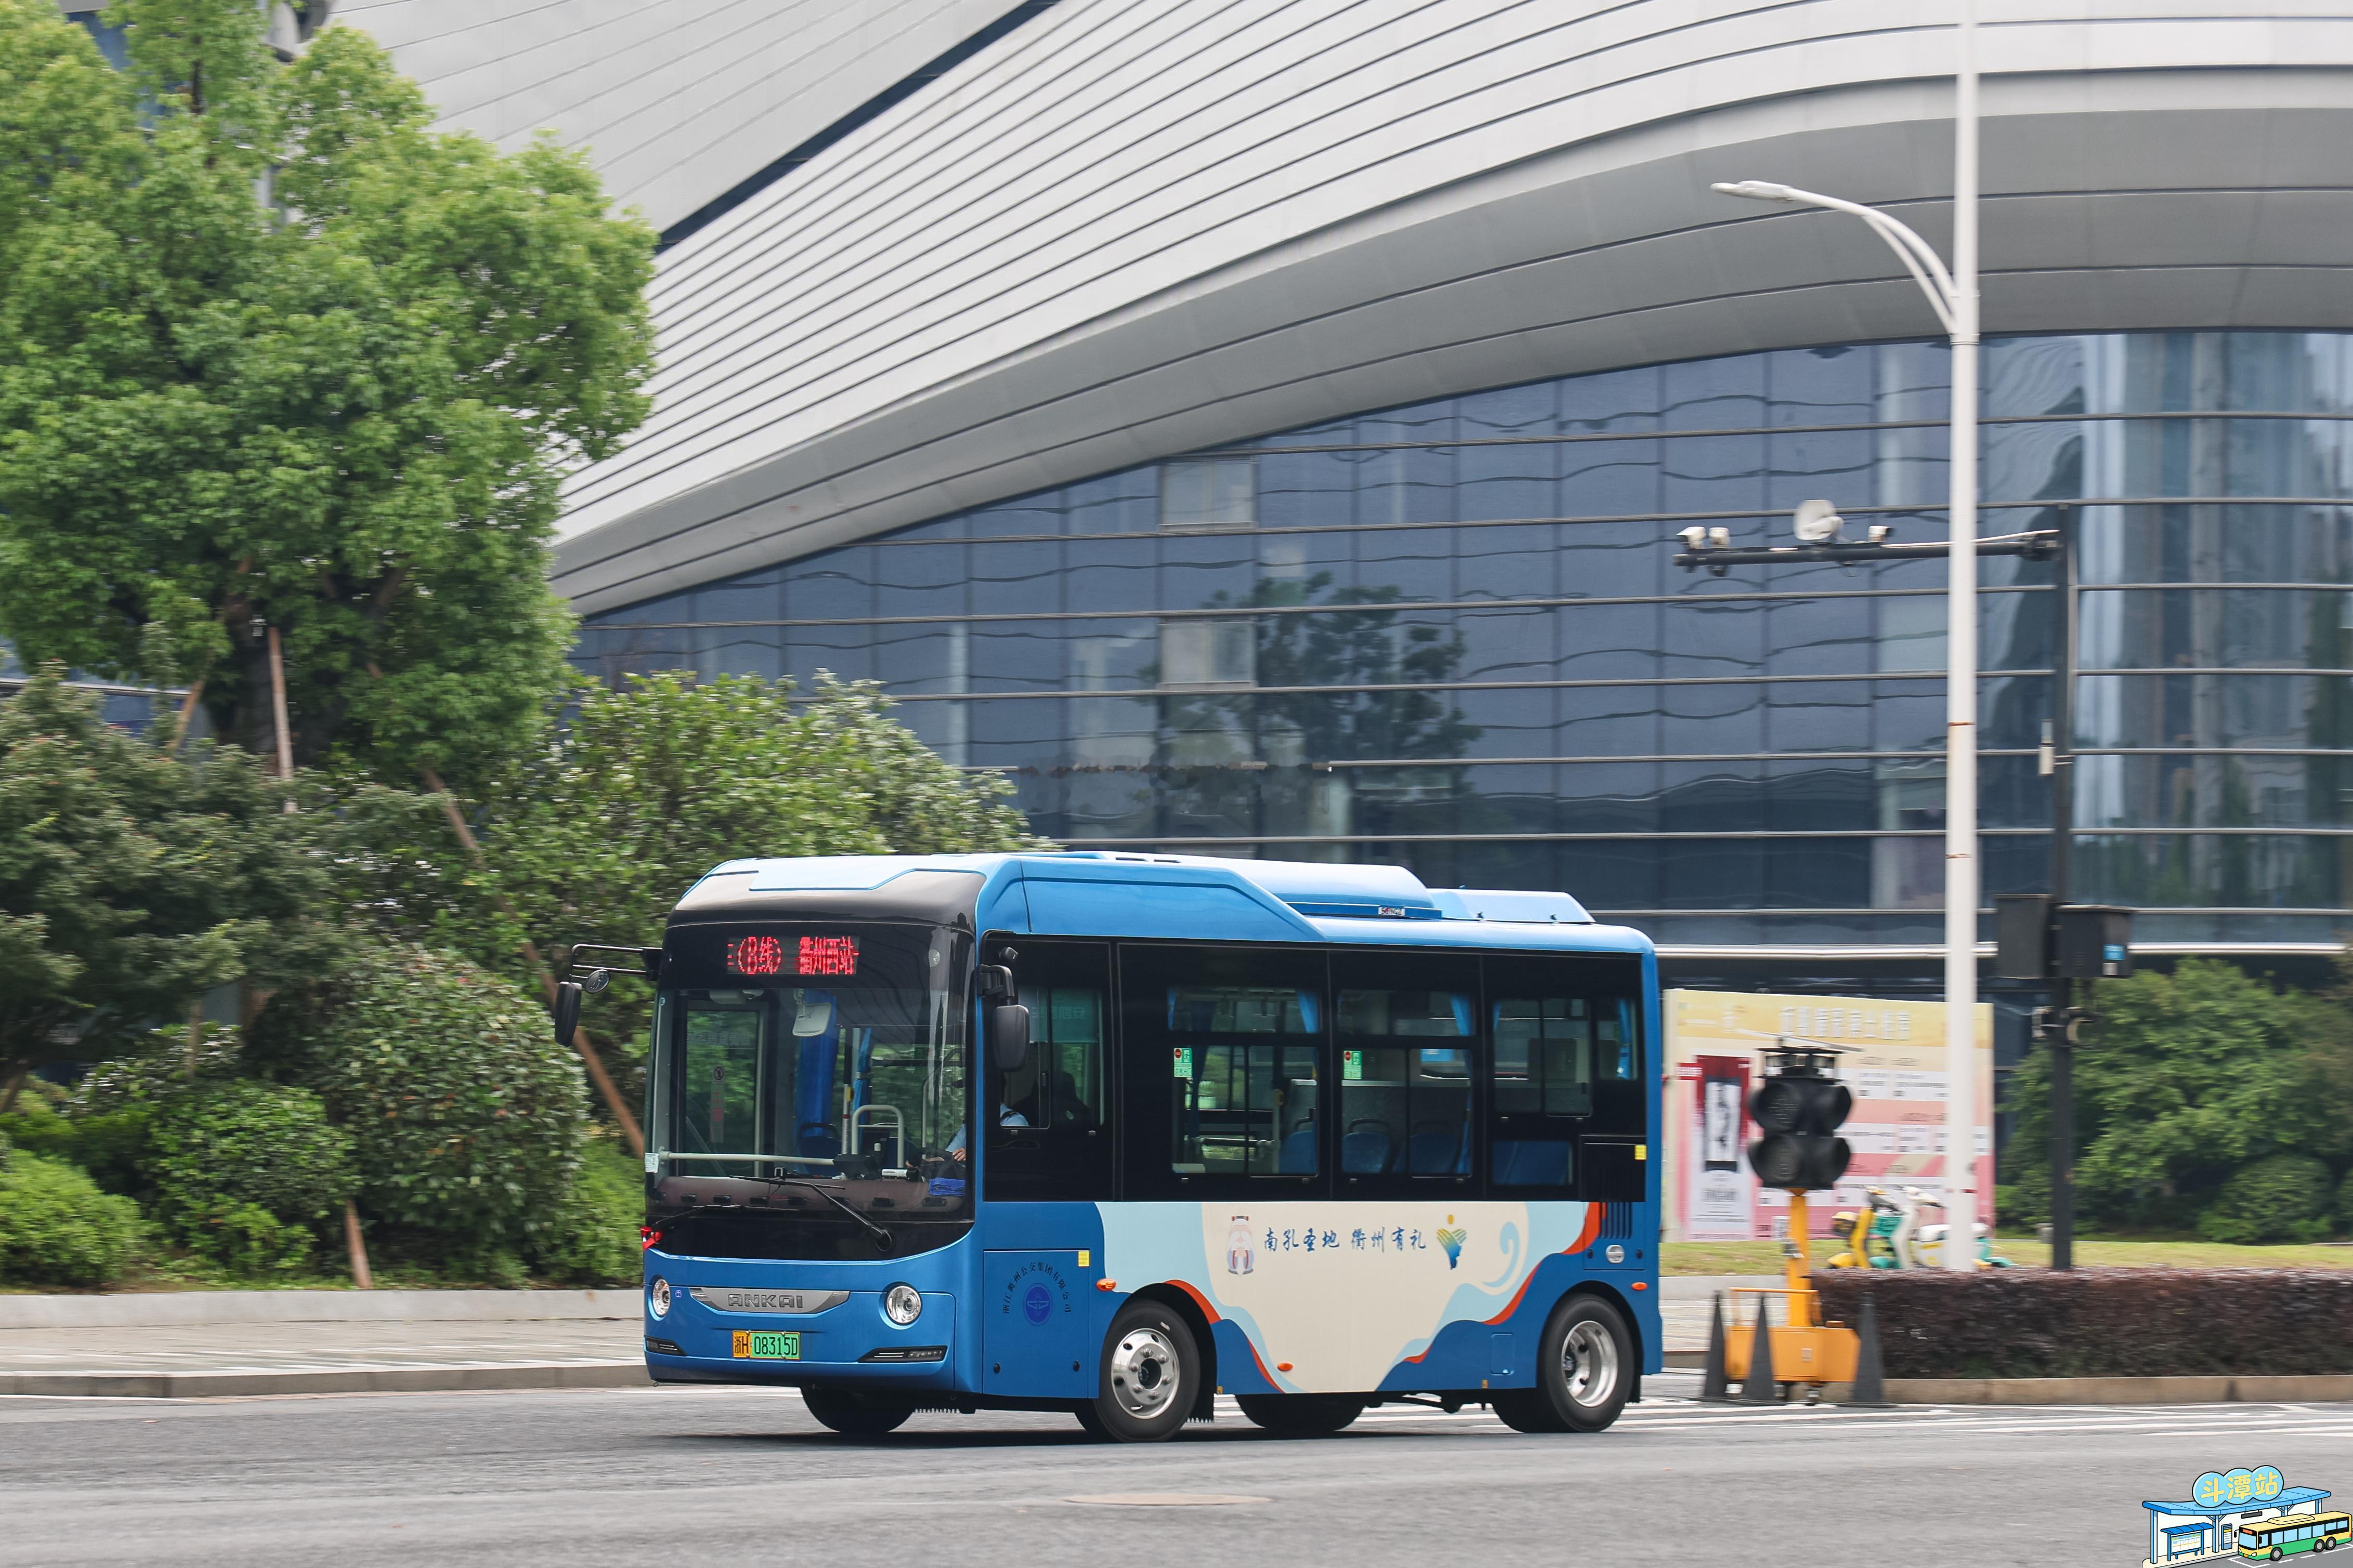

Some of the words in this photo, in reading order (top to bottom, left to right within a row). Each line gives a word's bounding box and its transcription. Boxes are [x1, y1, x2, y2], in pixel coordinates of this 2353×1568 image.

[1264, 1226, 1340, 1252] 南孔圣地
[1350, 1226, 1427, 1253] 衢州有礼
[728, 1293, 803, 1308] ANKAI
